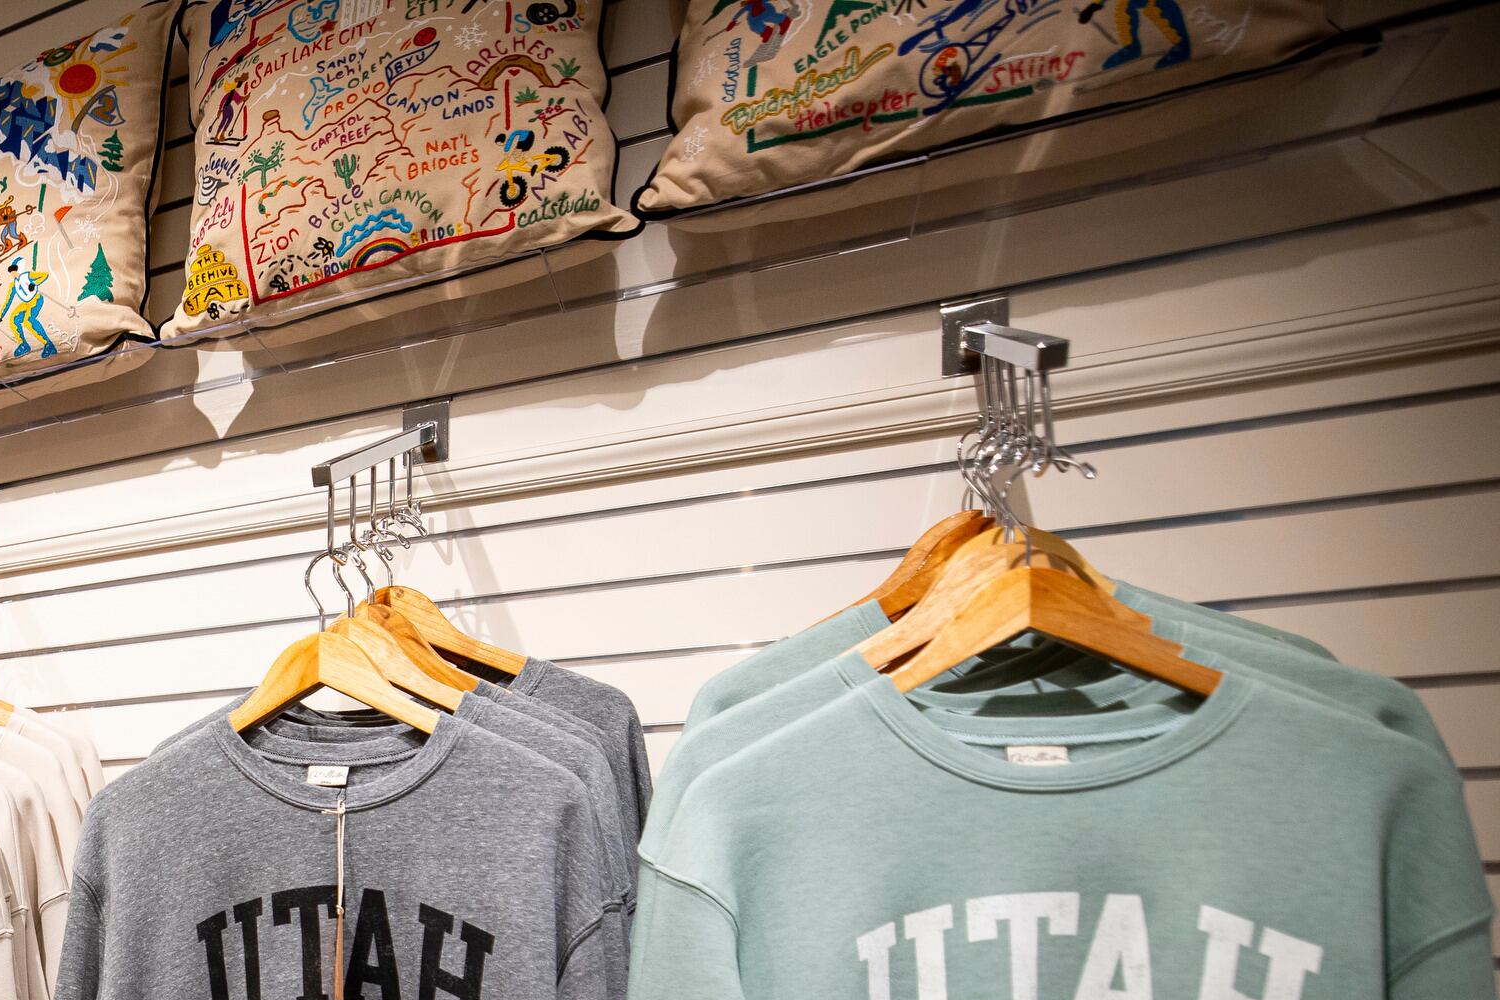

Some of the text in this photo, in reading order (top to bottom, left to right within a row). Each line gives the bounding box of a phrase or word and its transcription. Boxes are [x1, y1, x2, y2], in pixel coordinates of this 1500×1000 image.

[251, 51, 289, 90] SALT
[292, 34, 334, 65] LAKE
[338, 17, 378, 46] CITY
[316, 49, 367, 74] SANDY
[348, 52, 392, 89] OREM
[394, 51, 426, 74] BYU
[466, 36, 555, 76] ARCHES
[794, 30, 850, 74] EAGLE
[324, 80, 386, 119] PROVO
[442, 95, 495, 120] LANDS
[795, 50, 1086, 132] Helicopter Skiing
[311, 113, 365, 152] CAPITOL
[339, 124, 372, 147] REEF
[425, 132, 473, 154] NAT'L
[407, 150, 481, 181] BRIDGES
[208, 196, 235, 229] Lily
[308, 184, 364, 229] Bryce
[331, 187, 443, 232] GLEN CANYON
[517, 188, 601, 229] catstudio
[197, 253, 219, 268] THE
[251, 227, 300, 266] Zion
[292, 222, 464, 290] RAINBOW BRIDGE
[187, 267, 237, 289] BEEHIVE
[185, 283, 243, 312] STATE
